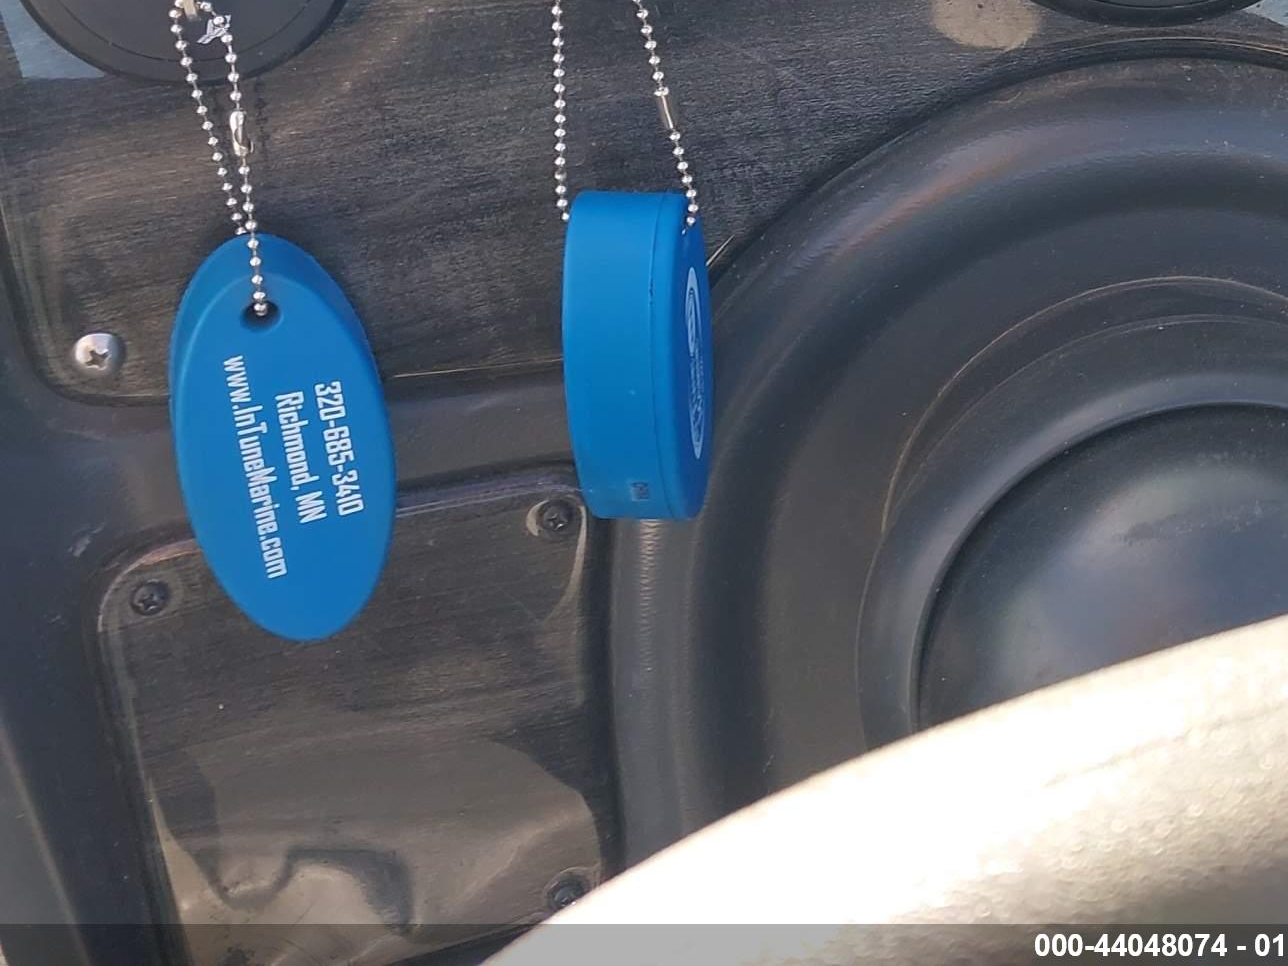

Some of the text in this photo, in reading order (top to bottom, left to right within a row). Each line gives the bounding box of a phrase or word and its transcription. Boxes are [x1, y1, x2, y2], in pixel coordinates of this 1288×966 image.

[223, 355, 287, 579] www.InTuneMarine.com
[275, 391, 327, 524] Richmond, MN
[314, 381, 364, 516] 320-685-3410
